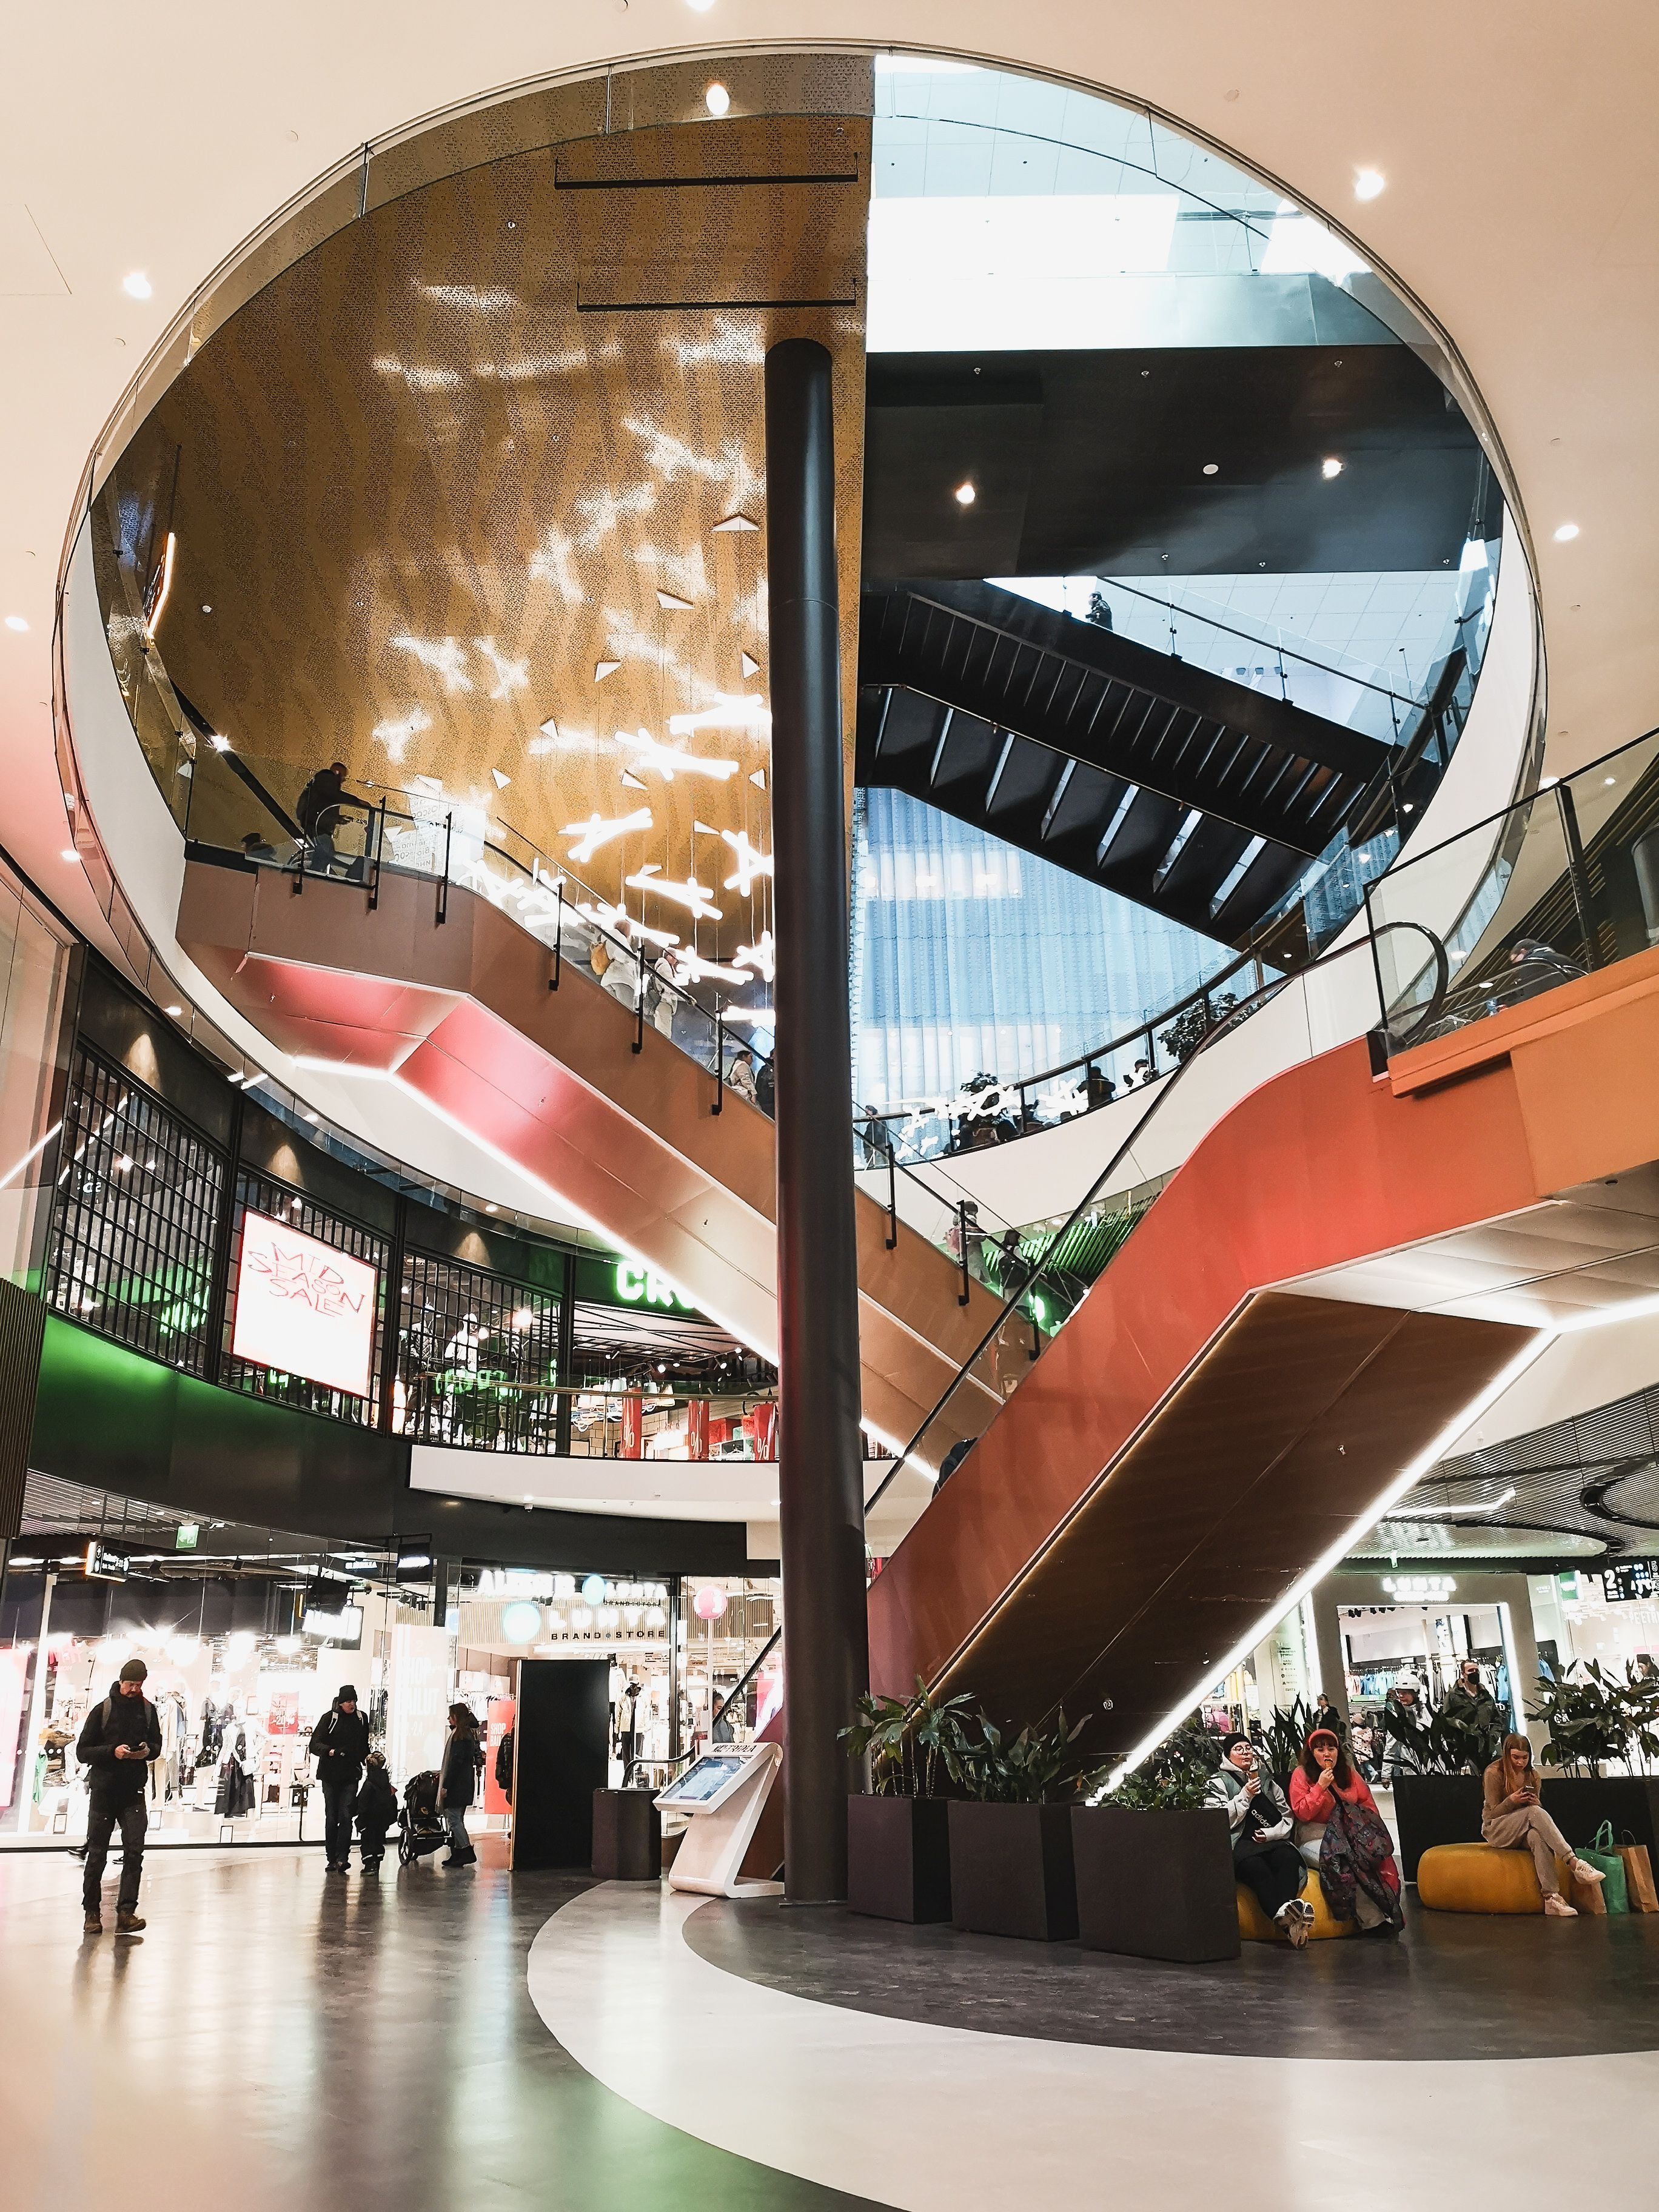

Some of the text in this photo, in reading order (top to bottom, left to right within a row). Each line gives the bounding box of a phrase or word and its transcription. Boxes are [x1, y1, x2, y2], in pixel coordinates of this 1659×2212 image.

[271, 1242, 344, 1284] MID
[247, 1250, 366, 1313] SEASON
[269, 1279, 344, 1318] SALE
[1604, 1569, 1617, 1589] 2
[551, 1630, 665, 1641] BRAND STORE
[490, 1722, 506, 1735] SHOP
